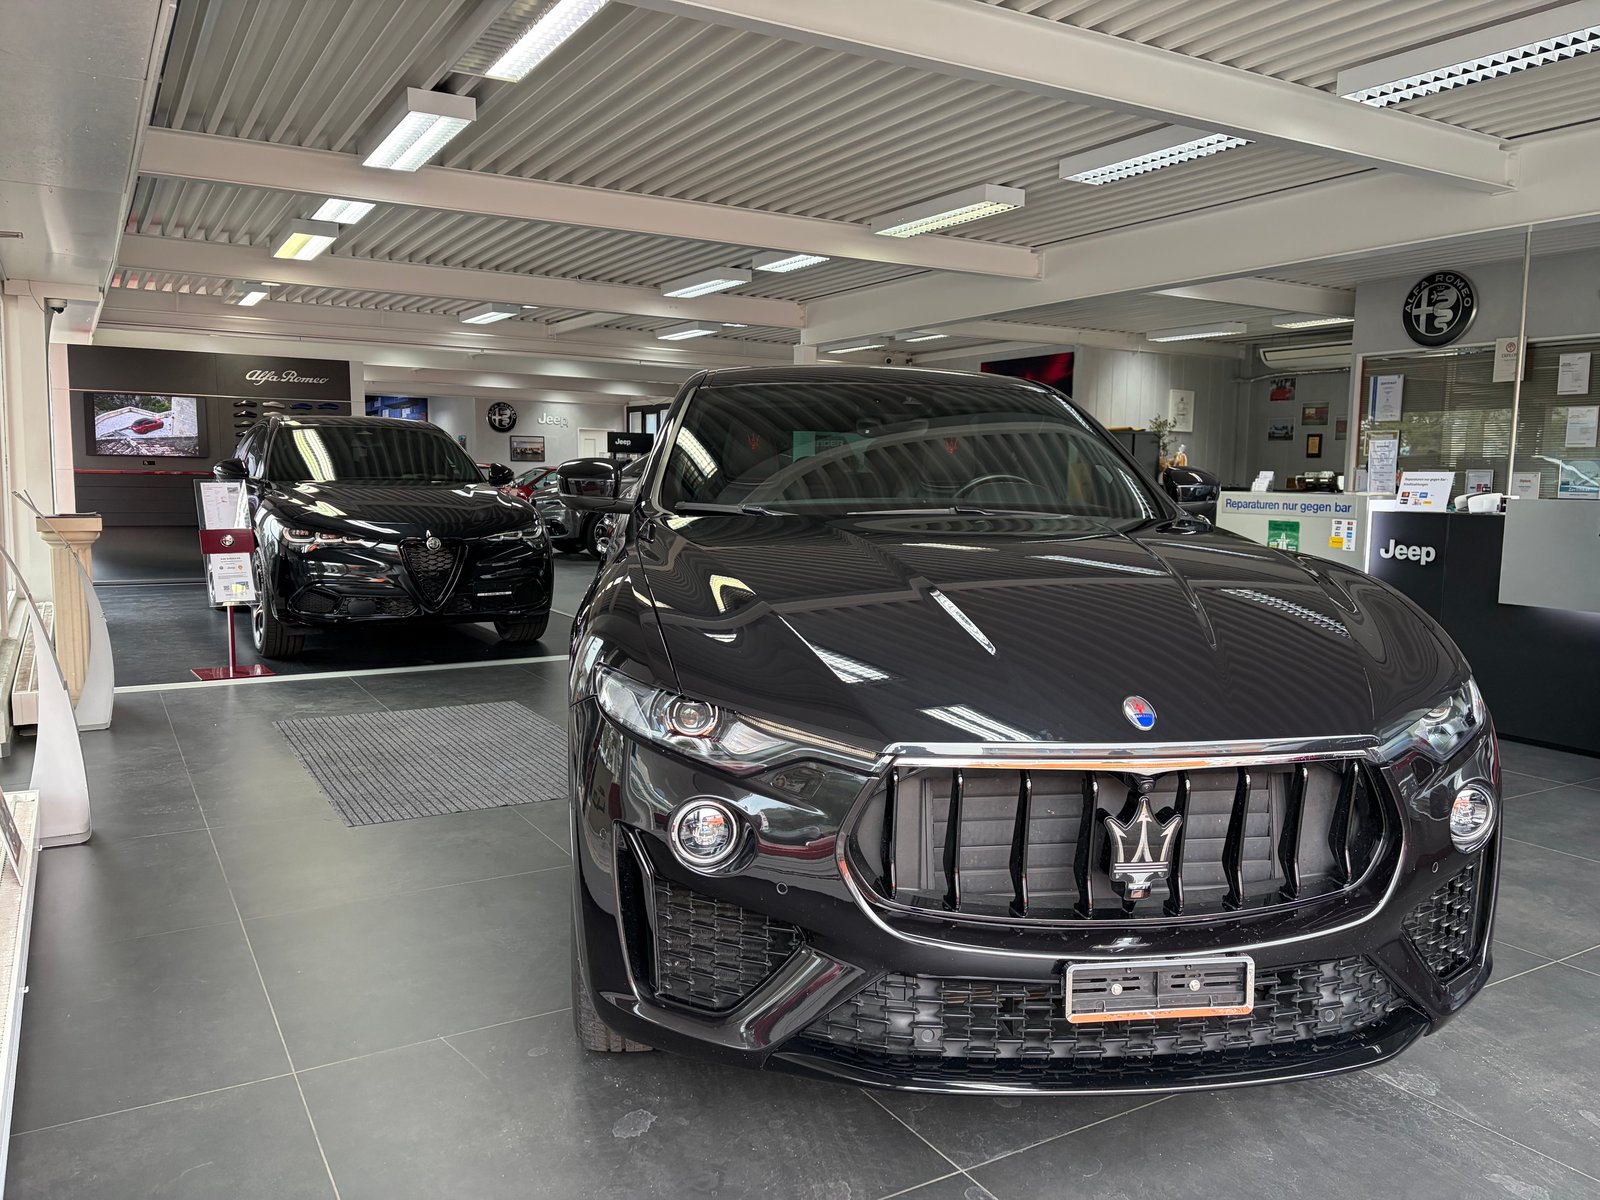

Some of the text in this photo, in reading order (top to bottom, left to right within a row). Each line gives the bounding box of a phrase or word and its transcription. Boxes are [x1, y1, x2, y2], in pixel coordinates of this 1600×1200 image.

[1405, 274, 1472, 313] ALFA ROMEO
[245, 369, 329, 386] Alfa Romeo
[537, 412, 569, 428] Jeep
[614, 437, 632, 446] Jeep
[1225, 498, 1352, 513] Reparaturen nur gegen bar
[1380, 539, 1436, 566] Jeep
